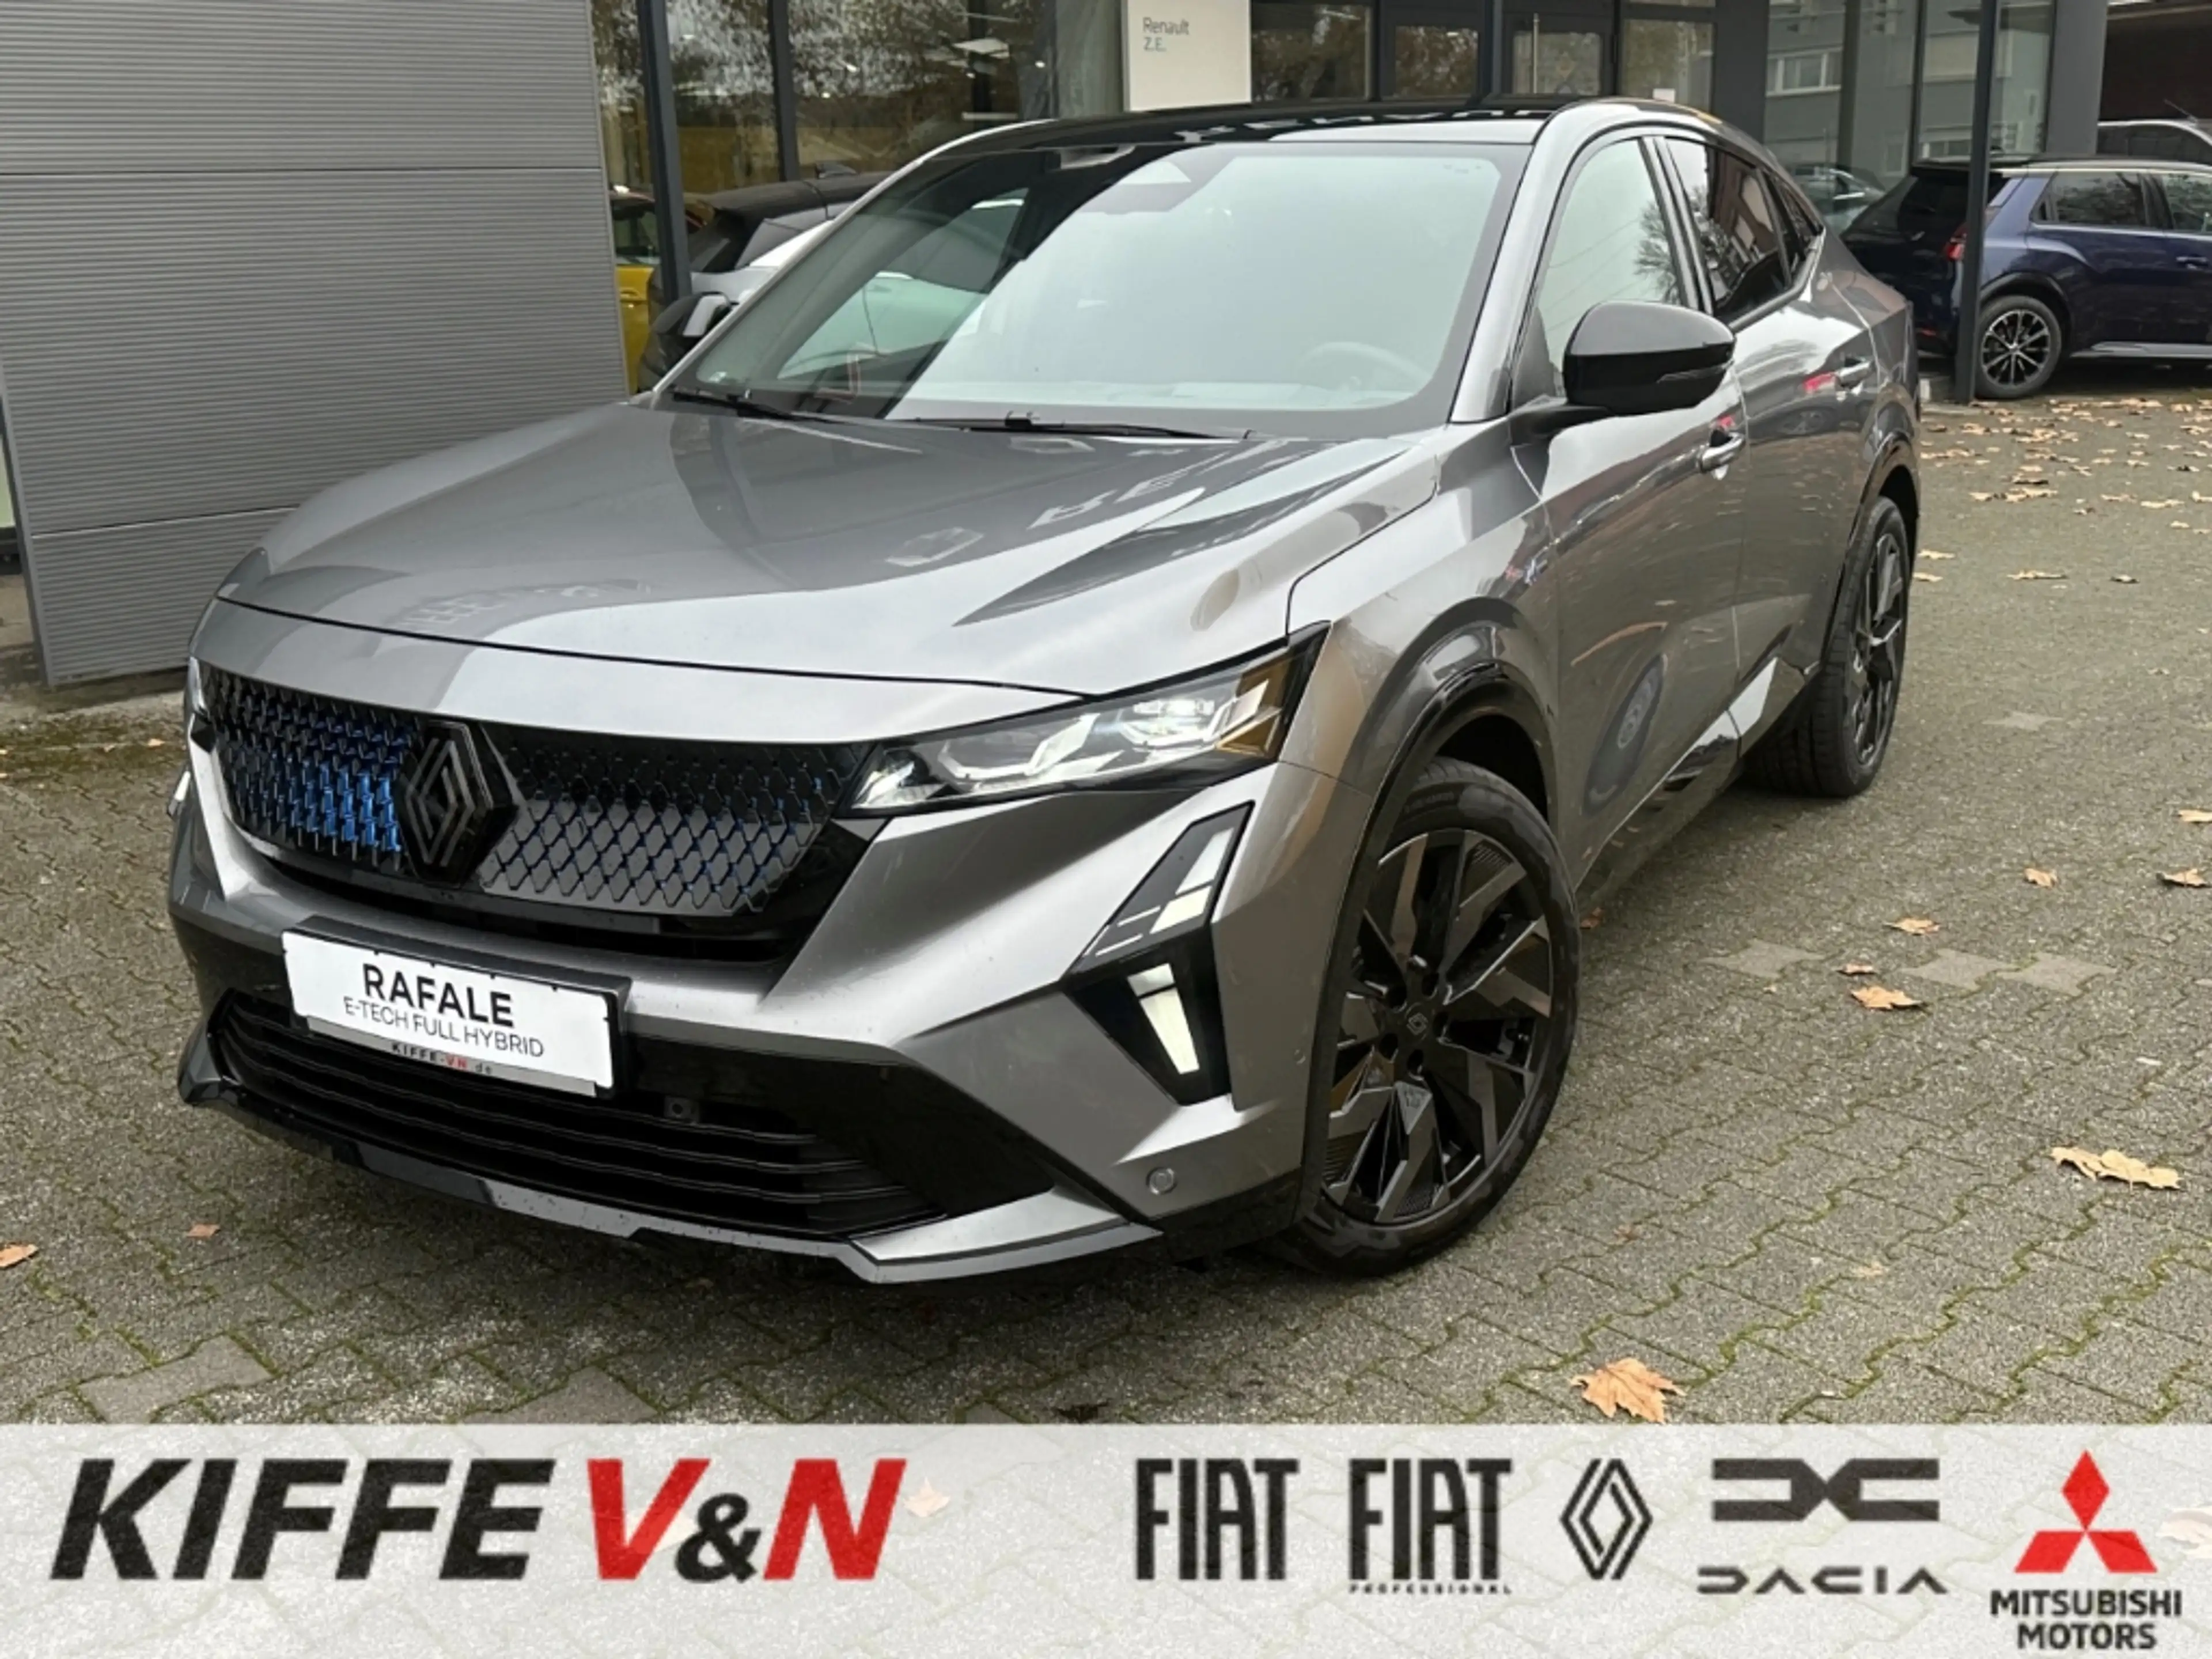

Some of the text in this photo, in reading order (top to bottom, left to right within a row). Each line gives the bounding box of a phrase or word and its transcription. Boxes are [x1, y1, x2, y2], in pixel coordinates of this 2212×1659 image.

[343, 996, 544, 1058] E-TECH FULL HYBRID
[363, 963, 514, 1028] RAFALE
